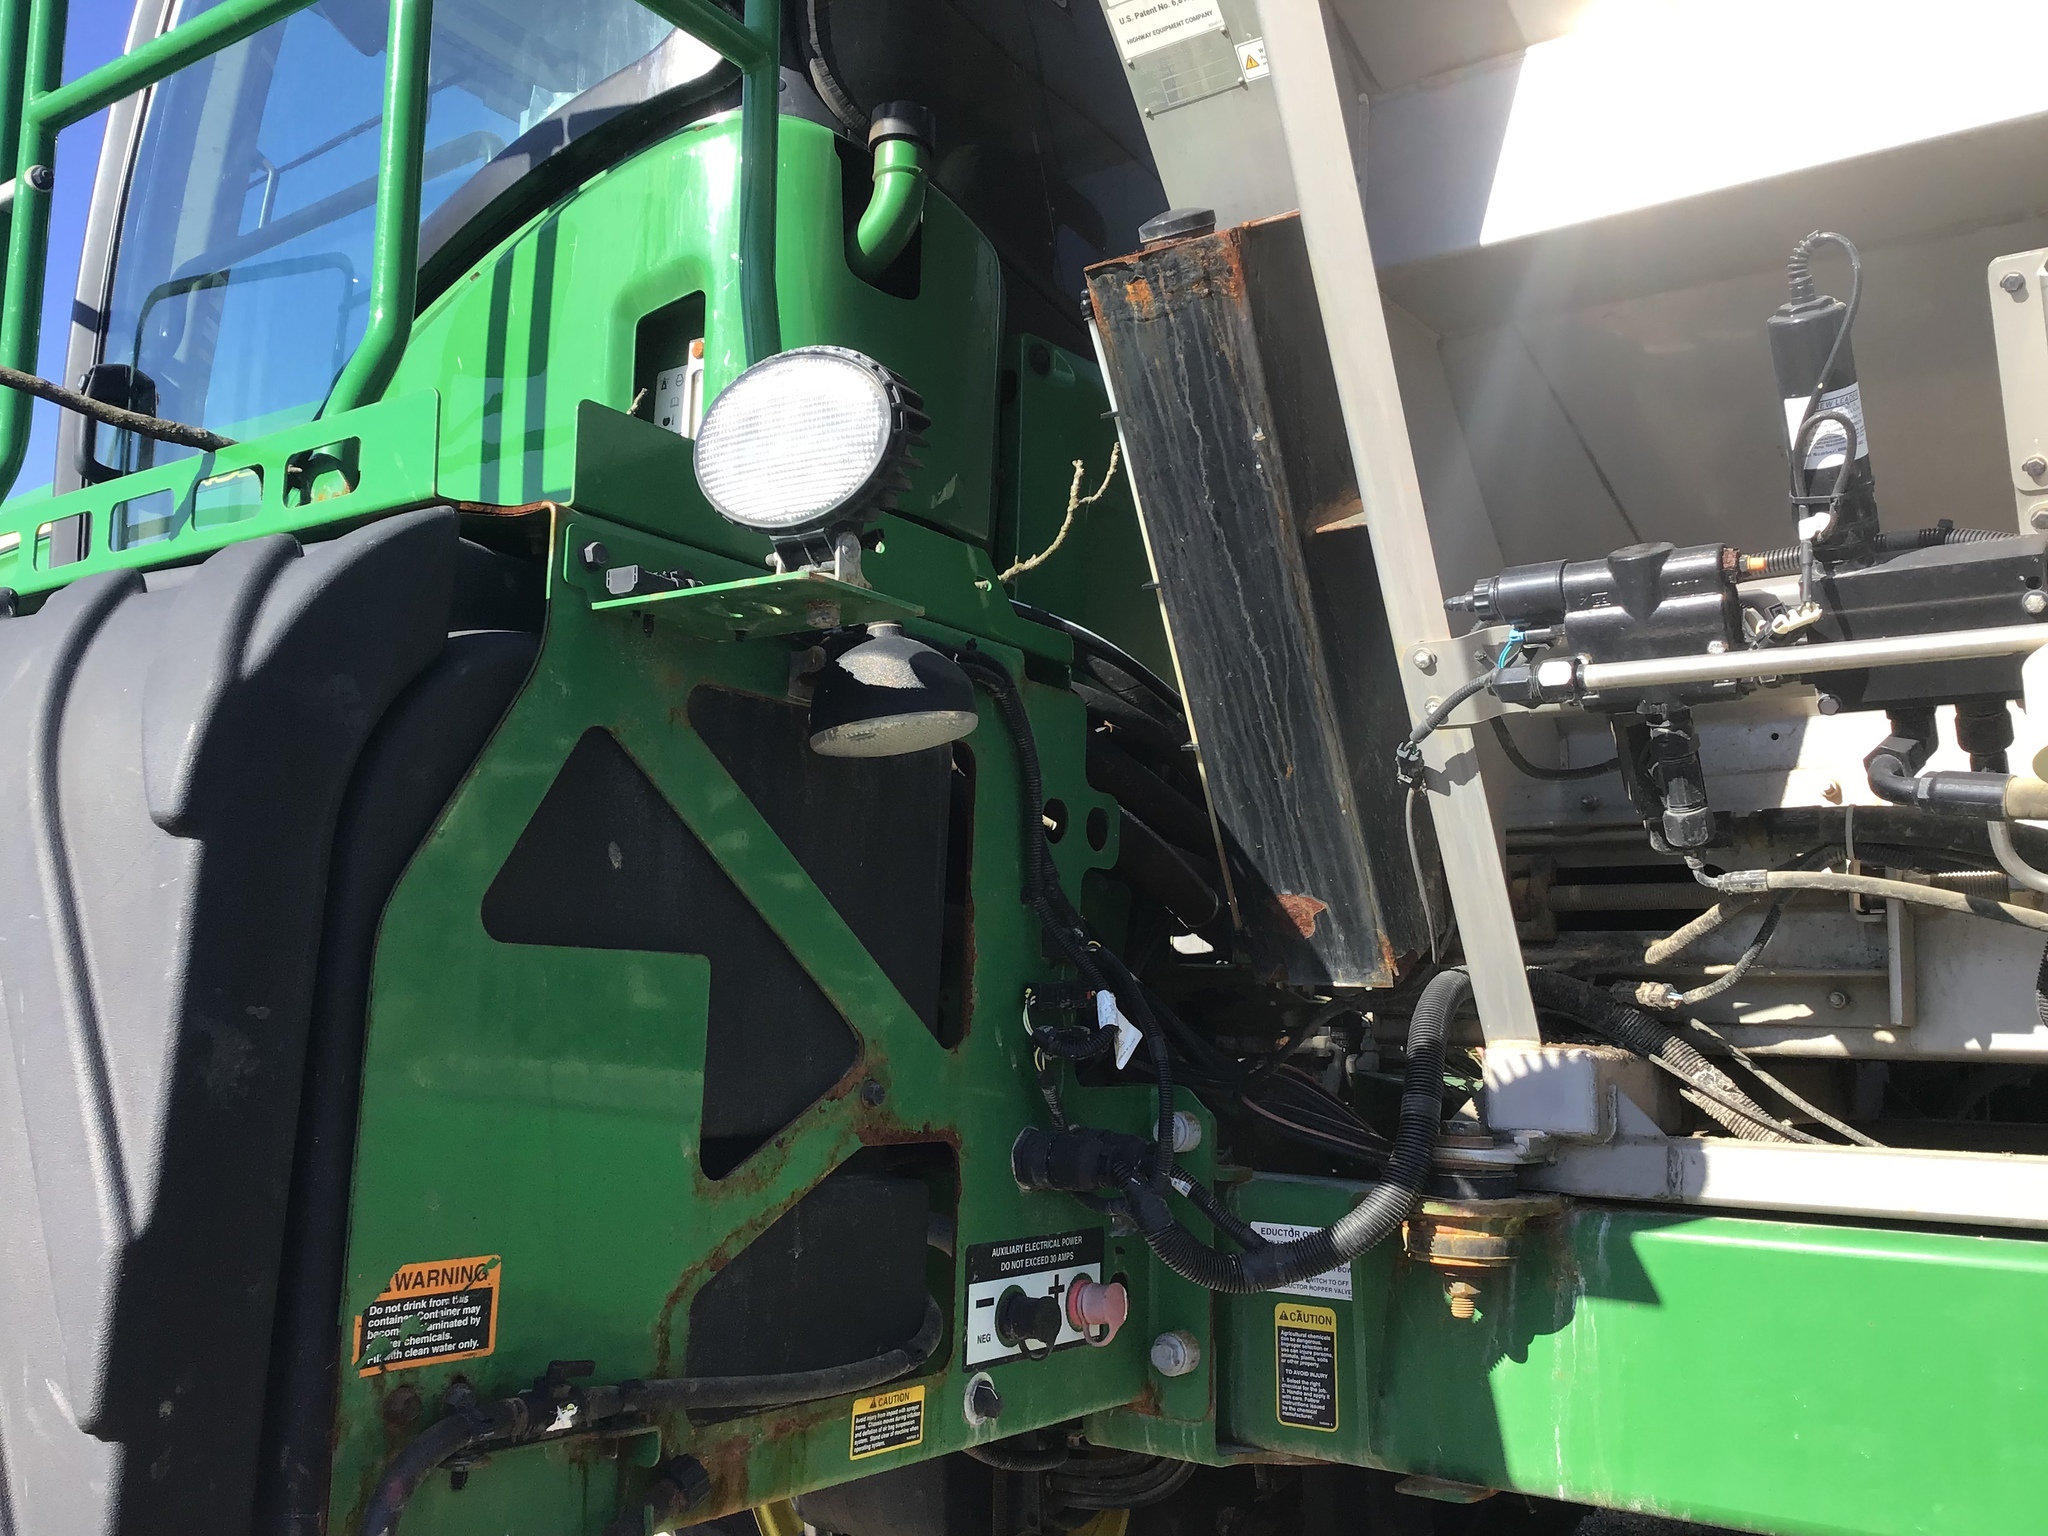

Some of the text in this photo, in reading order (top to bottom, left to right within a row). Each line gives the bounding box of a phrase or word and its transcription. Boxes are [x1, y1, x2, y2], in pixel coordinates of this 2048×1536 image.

[1119, 15, 1134, 25] U.S.
[1134, 6, 1158, 19] Patent
[1157, 3, 1171, 11] No.
[1127, 32, 1152, 45] HIGHWAY
[1152, 20, 1184, 36] EQUIPMENT
[1185, 10, 1213, 24] COMPANY
[1835, 392, 1858, 406] LEADER
[1261, 1227, 1300, 1238] EDUCTOR
[992, 1236, 1082, 1257] AUXILIARY ELECTRICAL POWER
[1000, 1252, 1074, 1271] DO NOT EXCEED 30 AMPS
[395, 1263, 487, 1291] WARNING
[1309, 1285, 1333, 1293] HOPPER
[369, 1306, 383, 1316] Do
[385, 1303, 401, 1312] not
[403, 1300, 426, 1311] drink
[429, 1298, 450, 1308] from
[462, 1305, 481, 1316] may
[1290, 1312, 1332, 1325] CAUTION
[367, 1327, 401, 1340] becom
[470, 1316, 481, 1326] by
[1281, 1330, 1307, 1338] Agricultural
[404, 1332, 453, 1346] chemicals.
[977, 1333, 991, 1344] NEG
[404, 1347, 429, 1358] clean
[432, 1343, 455, 1354] water
[458, 1339, 479, 1350] only.
[878, 1392, 910, 1407] CAUTION
